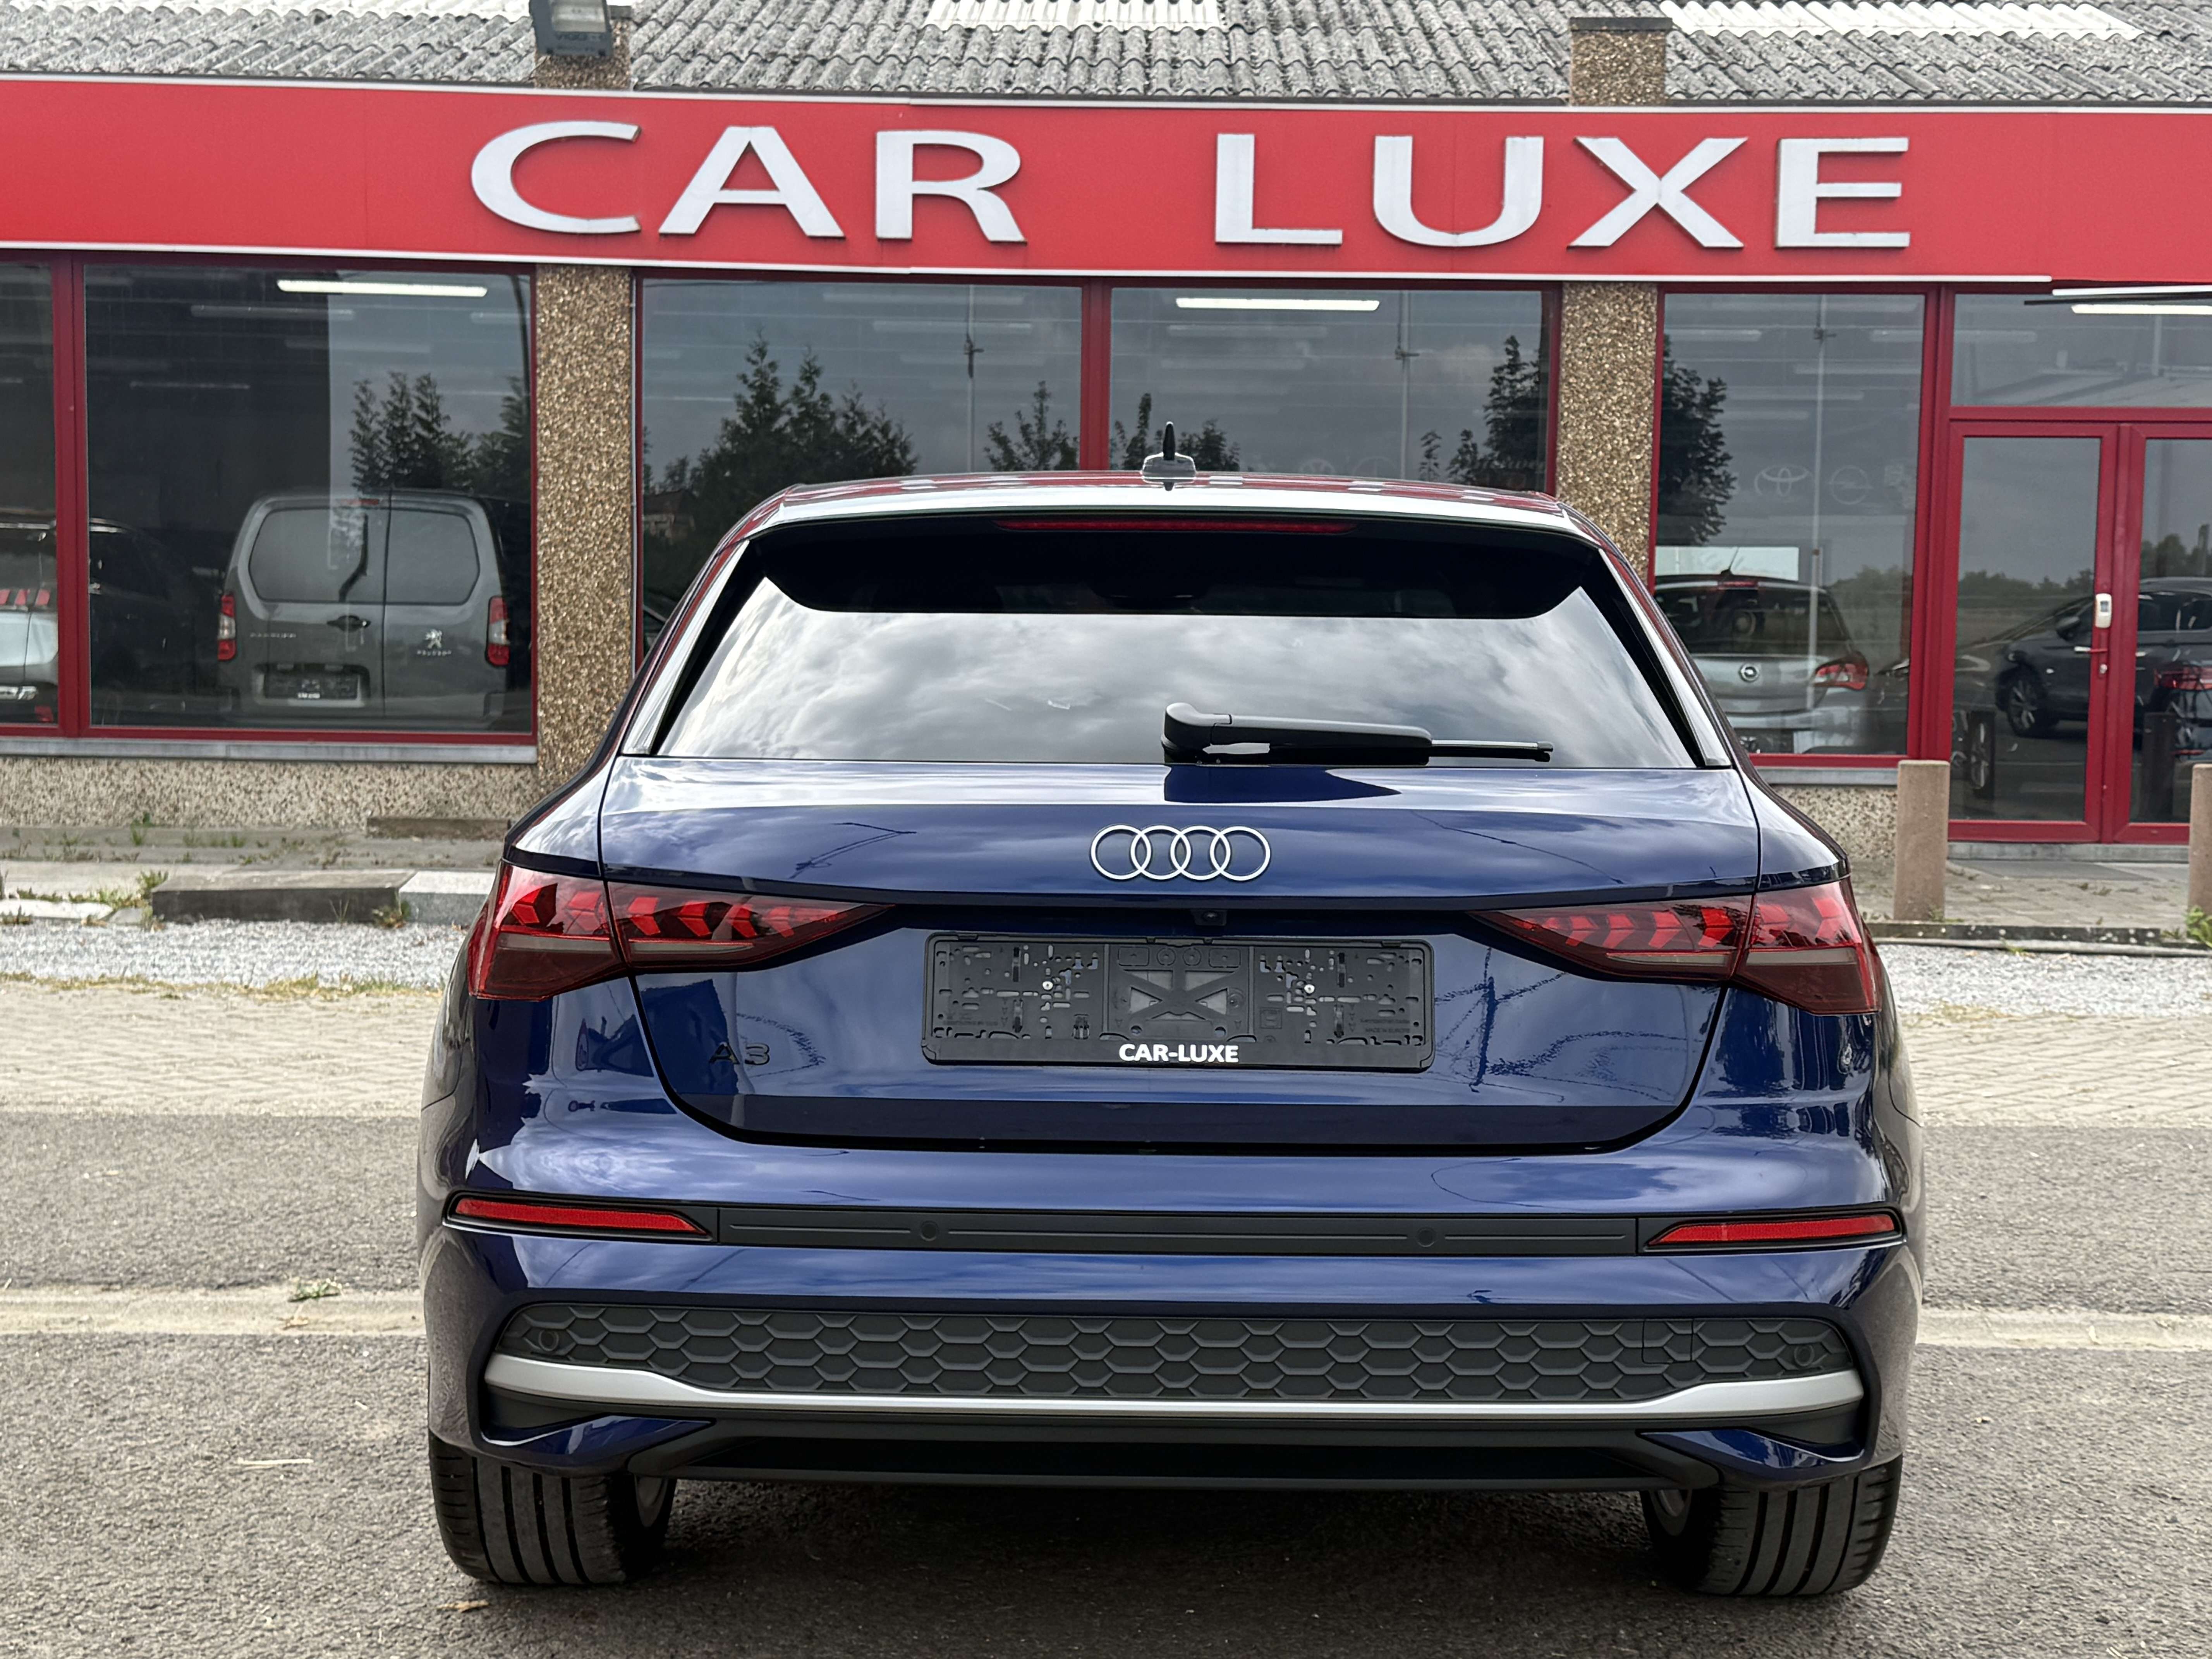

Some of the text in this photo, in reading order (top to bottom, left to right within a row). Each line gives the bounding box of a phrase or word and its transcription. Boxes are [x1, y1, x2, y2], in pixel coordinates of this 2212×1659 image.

[471, 120, 1911, 249] CAR LUXE
[708, 1042, 770, 1065] A3
[1119, 1043, 1239, 1063] CAR-LUXE
